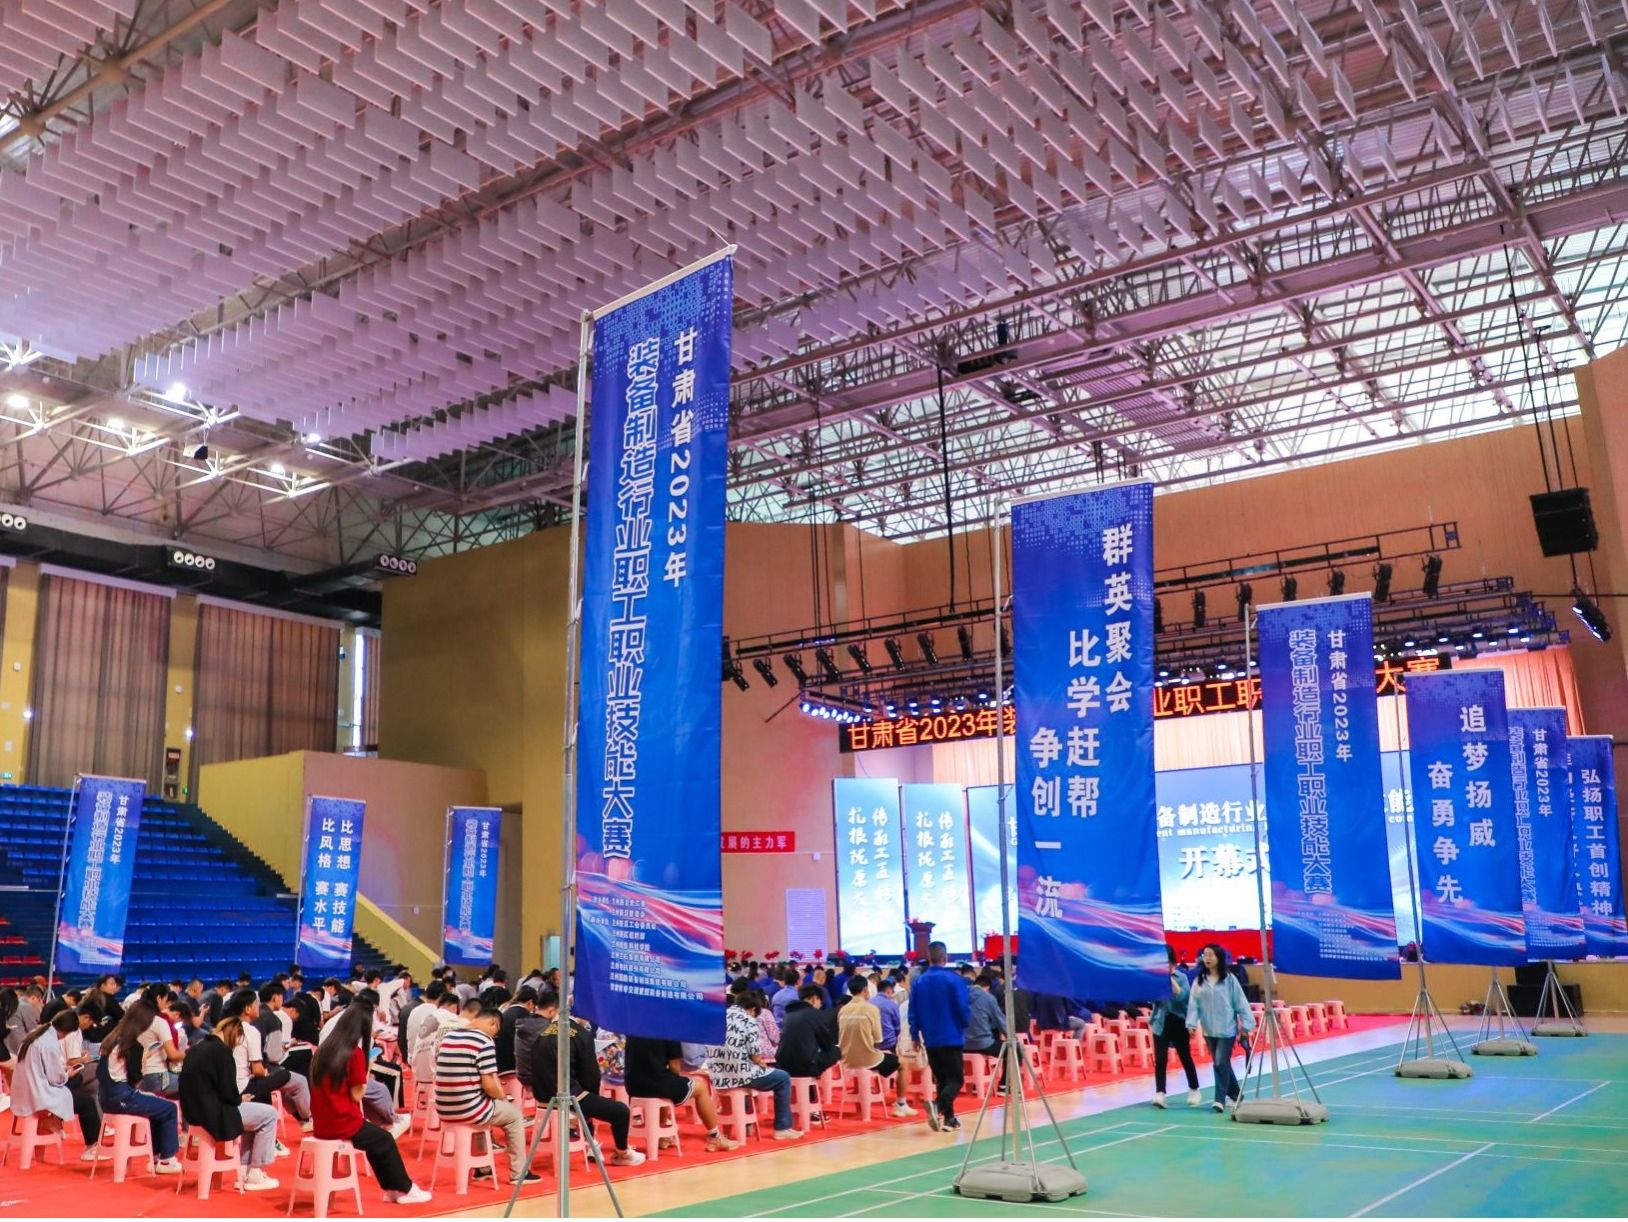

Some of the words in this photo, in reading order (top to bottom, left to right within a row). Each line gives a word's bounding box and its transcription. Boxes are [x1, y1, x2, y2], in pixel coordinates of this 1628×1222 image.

[663, 326, 699, 587] 甘肃省2023年
[602, 337, 660, 859] 装备制造行业职工职业技能大赛
[1103, 522, 1133, 713] 群英聚会
[1067, 629, 1101, 818] 比学赶帮
[1289, 629, 1332, 894] 装备制造行业职工职业技能大赛
[1327, 629, 1353, 762] 甘肃省2023年
[109, 795, 129, 865] 甘肃省2023年
[1029, 726, 1063, 918] 争创一流
[1177, 823, 1254, 836] manufacturin
[1428, 761, 1464, 903] 奋勇争先
[1460, 704, 1495, 847] 追梦扬威
[1532, 728, 1552, 817] 甘肃省2023年
[312, 881, 330, 932] 赛水平
[317, 818, 335, 869] 比风格
[331, 882, 349, 933] 赛技能
[337, 820, 353, 869] 比思想
[721, 835, 787, 849] 展的主力军
[1581, 769, 1612, 916] 弘扬职工首创精神
